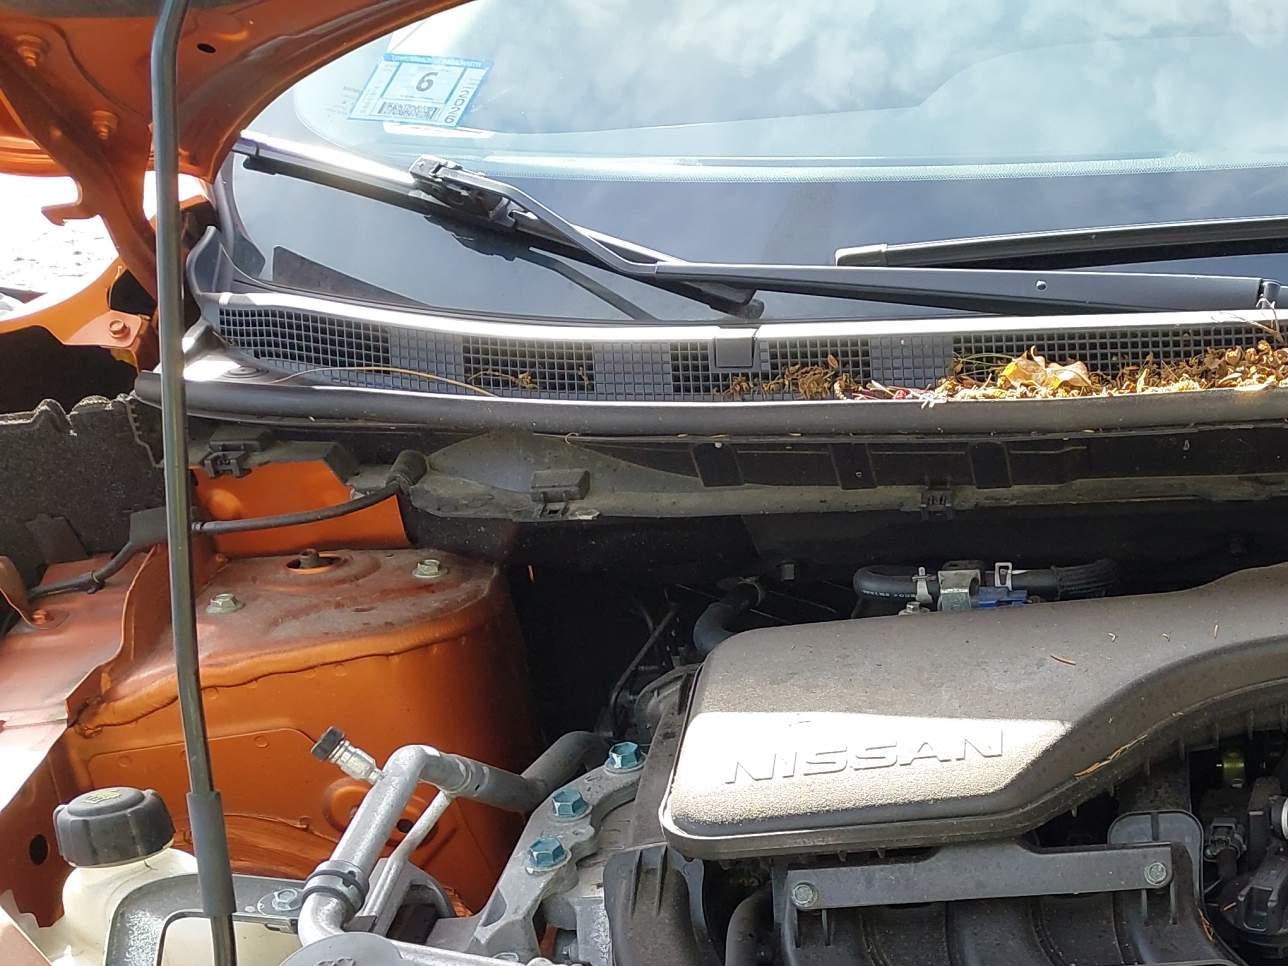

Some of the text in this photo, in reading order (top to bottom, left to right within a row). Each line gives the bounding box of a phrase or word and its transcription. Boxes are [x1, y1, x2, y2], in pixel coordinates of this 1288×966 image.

[415, 71, 439, 92] 6
[444, 90, 470, 124] 2026
[725, 731, 1004, 785] NISSAN
